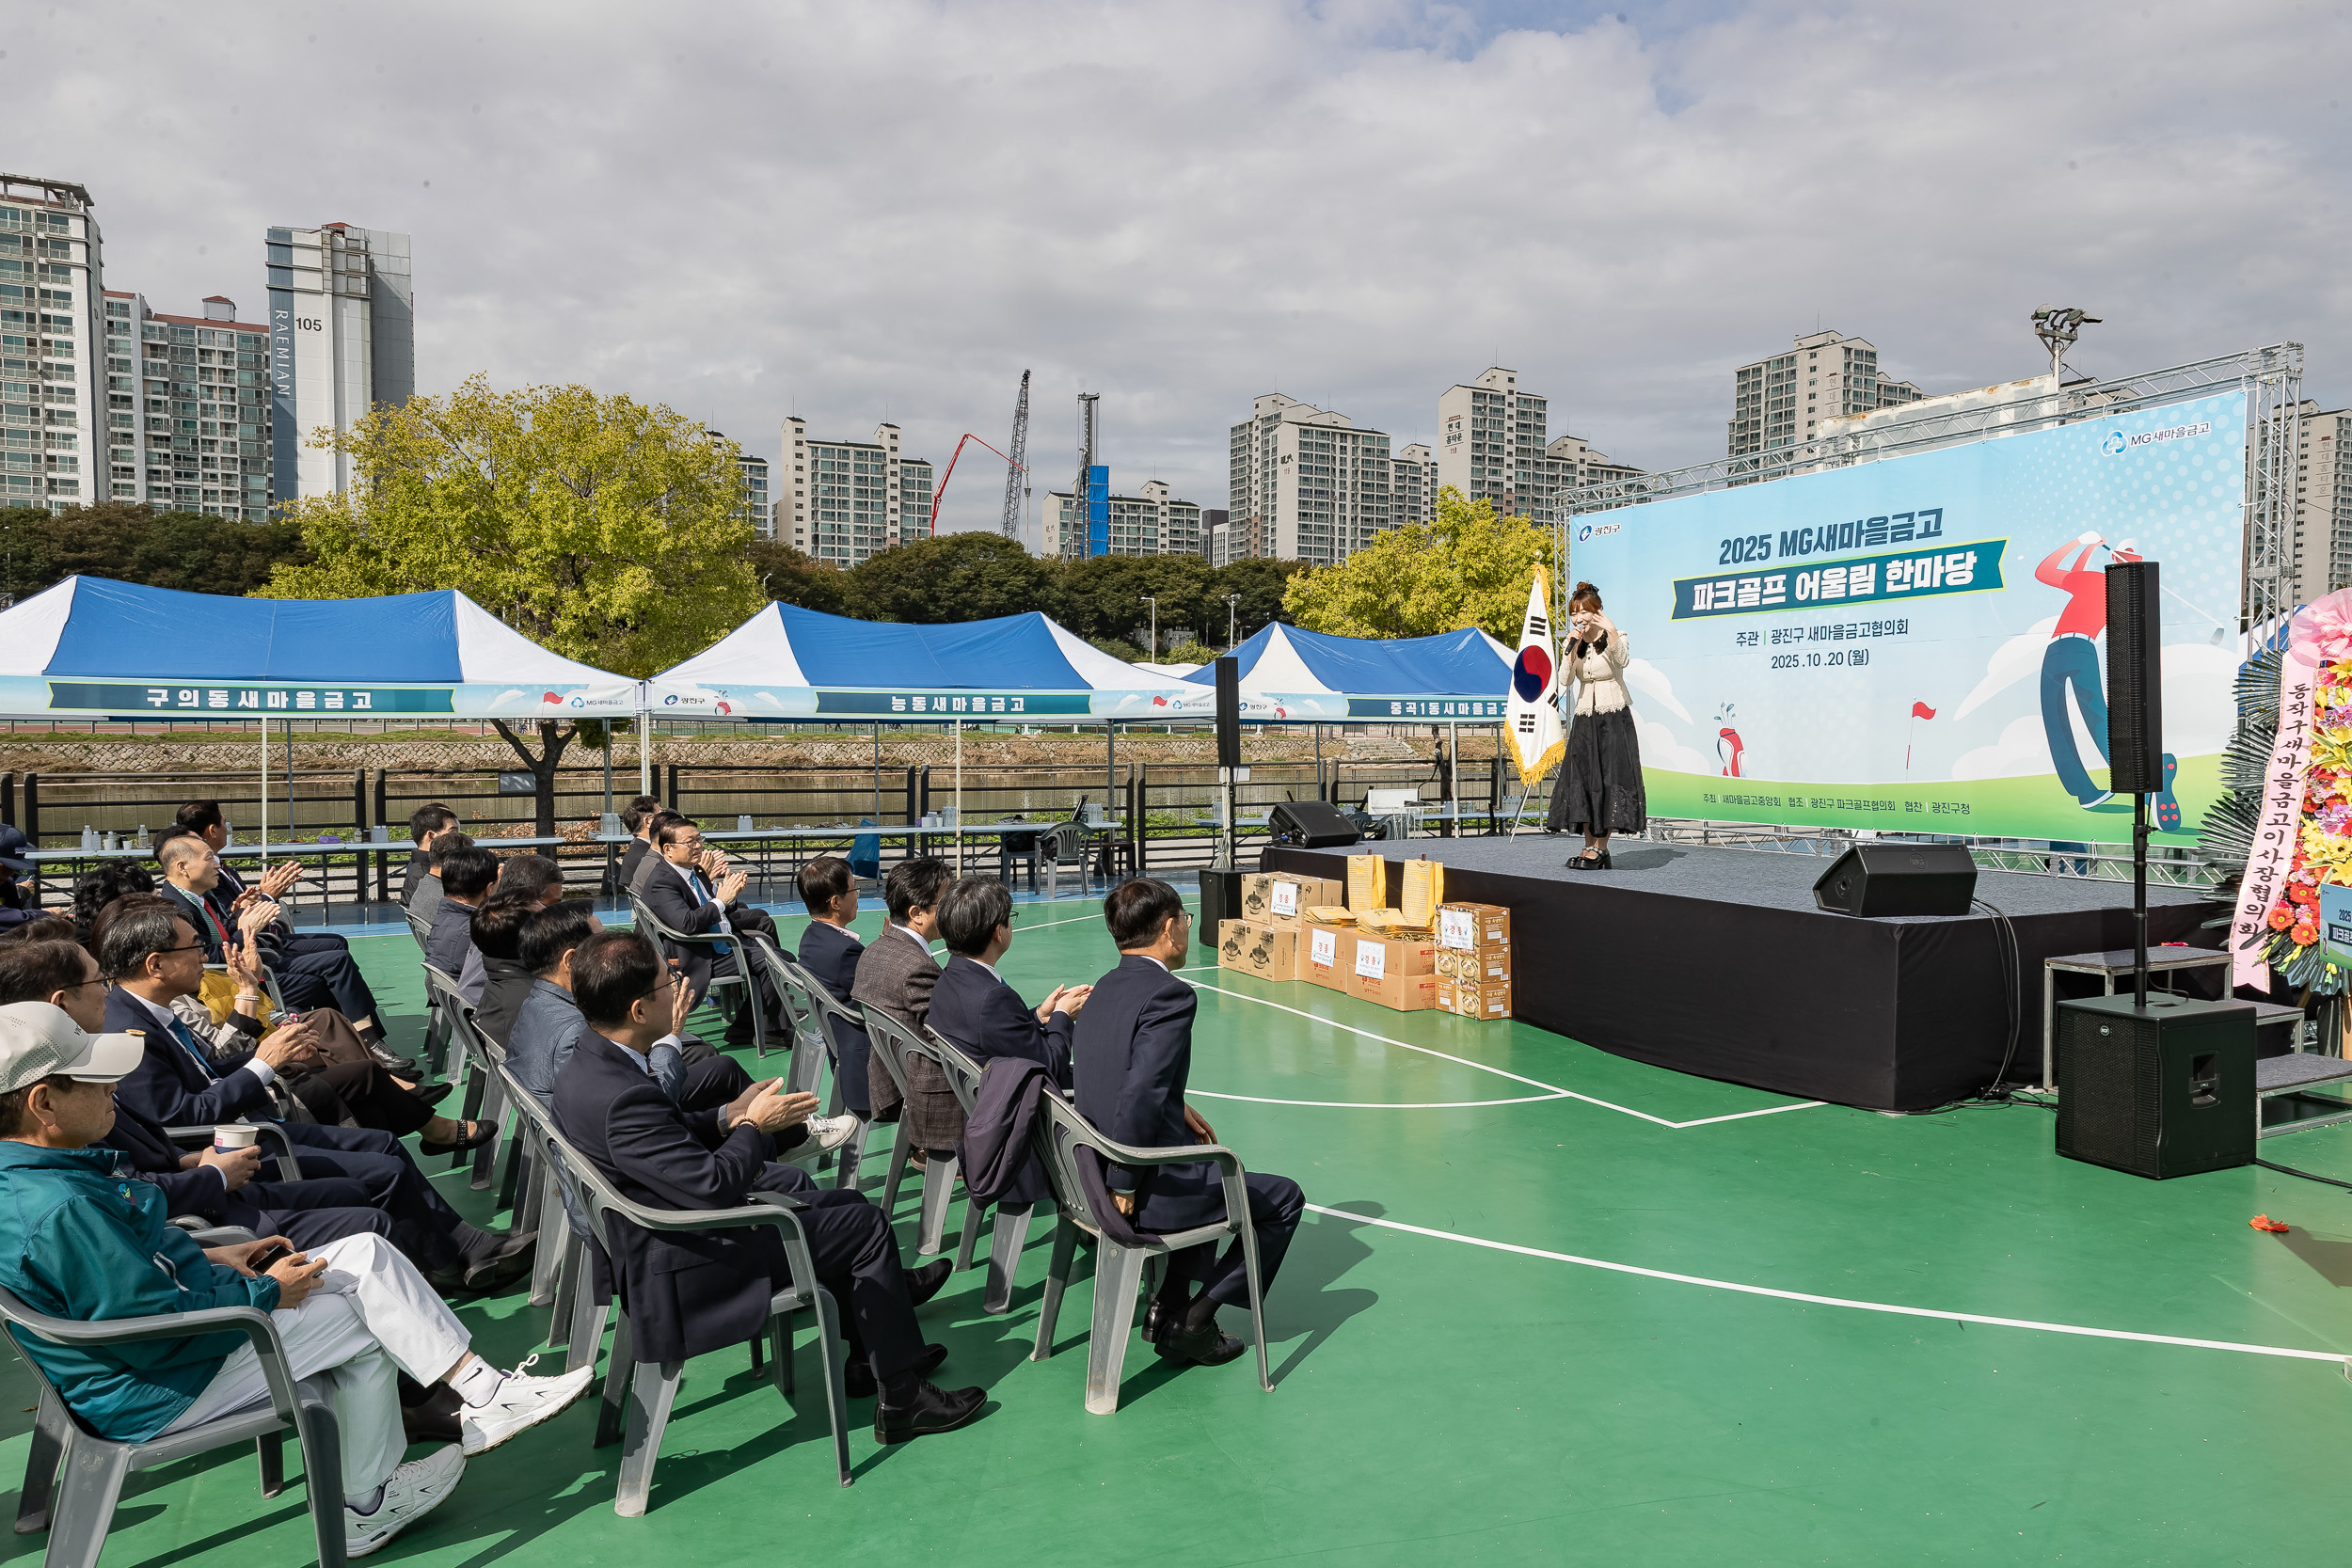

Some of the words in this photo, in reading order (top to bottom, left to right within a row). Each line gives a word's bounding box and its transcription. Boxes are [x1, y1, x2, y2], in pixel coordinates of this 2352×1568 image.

[295, 317, 322, 332] 105
[275, 309, 290, 396] RAEMIAN
[1447, 420, 1461, 432] 현대
[1446, 433, 1462, 444] 홈타운
[1595, 524, 1620, 536] 광진구
[1719, 533, 1772, 565] 2025
[1778, 508, 1944, 558] MG새마을금고
[1692, 574, 1787, 611] 파크골프
[1795, 562, 1877, 601] 어울림
[1885, 551, 1978, 593] 한마당
[1736, 630, 1759, 647] 주관
[1771, 627, 1804, 645] 광진구
[1807, 618, 1909, 641] 새마을금고협의회
[1848, 648, 1869, 667] (월)
[147, 689, 373, 709] 구의동새마을금고
[891, 695, 1025, 712] 능동새마을금고
[1703, 793, 1716, 803] 주최
[1723, 794, 1781, 807] 새마을금고중앙회
[1788, 797, 1804, 807] 협조
[1810, 798, 1835, 809] 광진구
[1836, 799, 1896, 812] 파크골프협의회
[1904, 800, 1923, 813] 협찬
[1931, 801, 1970, 816] 광진구청
[2339, 909, 2352, 922] 2025
